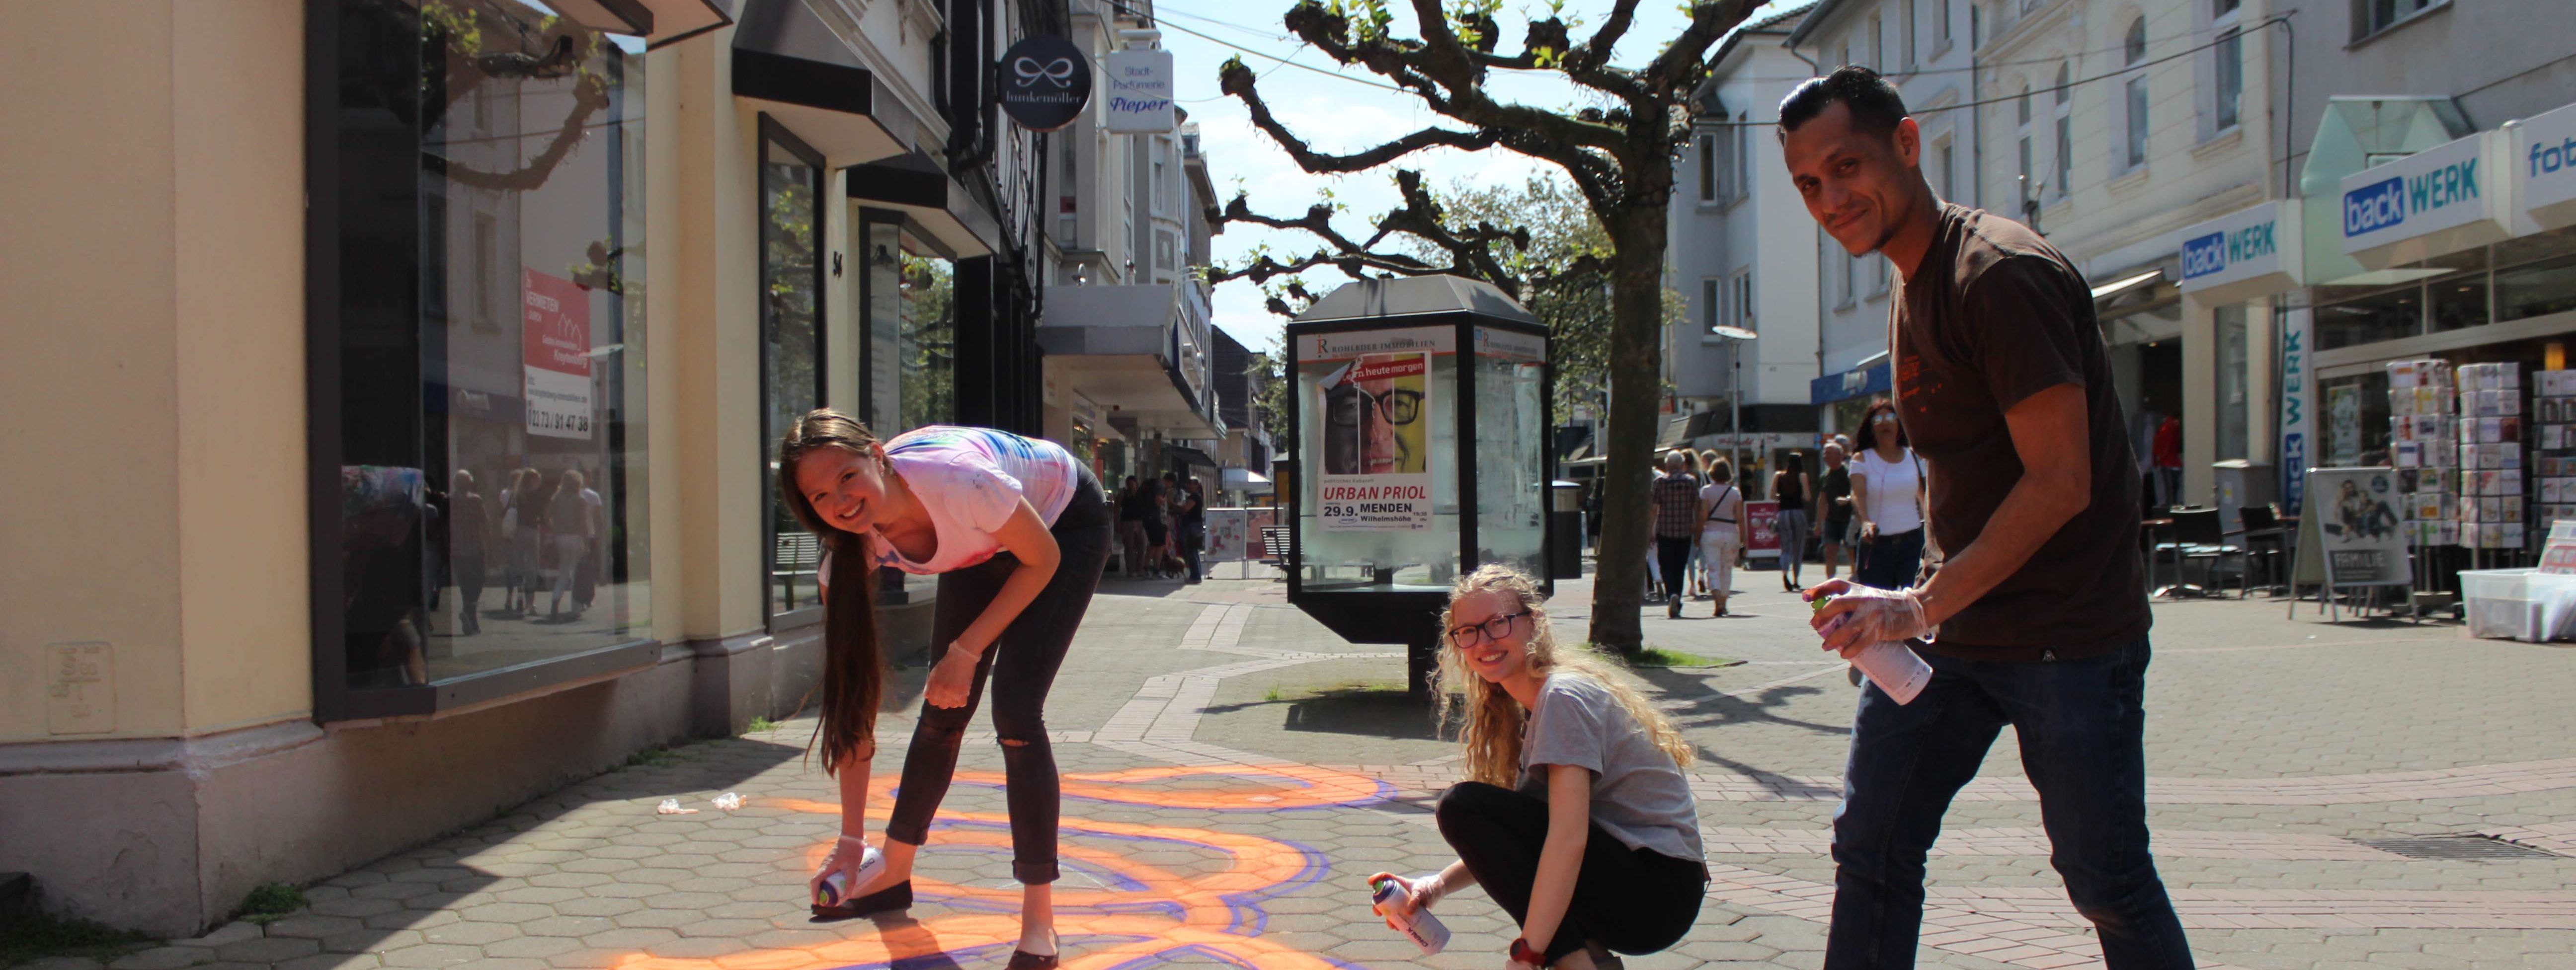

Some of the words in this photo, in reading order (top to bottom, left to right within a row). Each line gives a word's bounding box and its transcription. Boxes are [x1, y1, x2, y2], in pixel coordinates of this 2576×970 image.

[1125, 66, 1153, 76] Stadt-
[1113, 79, 1165, 90] Parfümerie
[1110, 96, 1168, 114] Pieper
[2346, 183, 2402, 233] back
[2409, 156, 2479, 215] WERK
[2184, 236, 2224, 276] back
[2228, 219, 2276, 264] WERK
[1366, 365, 1390, 376] heute
[1391, 363, 1423, 375] morgen
[2285, 329, 2302, 426] WERK
[566, 414, 575, 431] 47
[578, 416, 589, 432] 38
[1324, 486, 1379, 500] URBAN
[1383, 486, 1426, 500] PRIOL
[1324, 506, 1359, 517] 29.9.
[1360, 503, 1412, 513] MENDEN
[1407, 927, 1428, 947] CHALK
